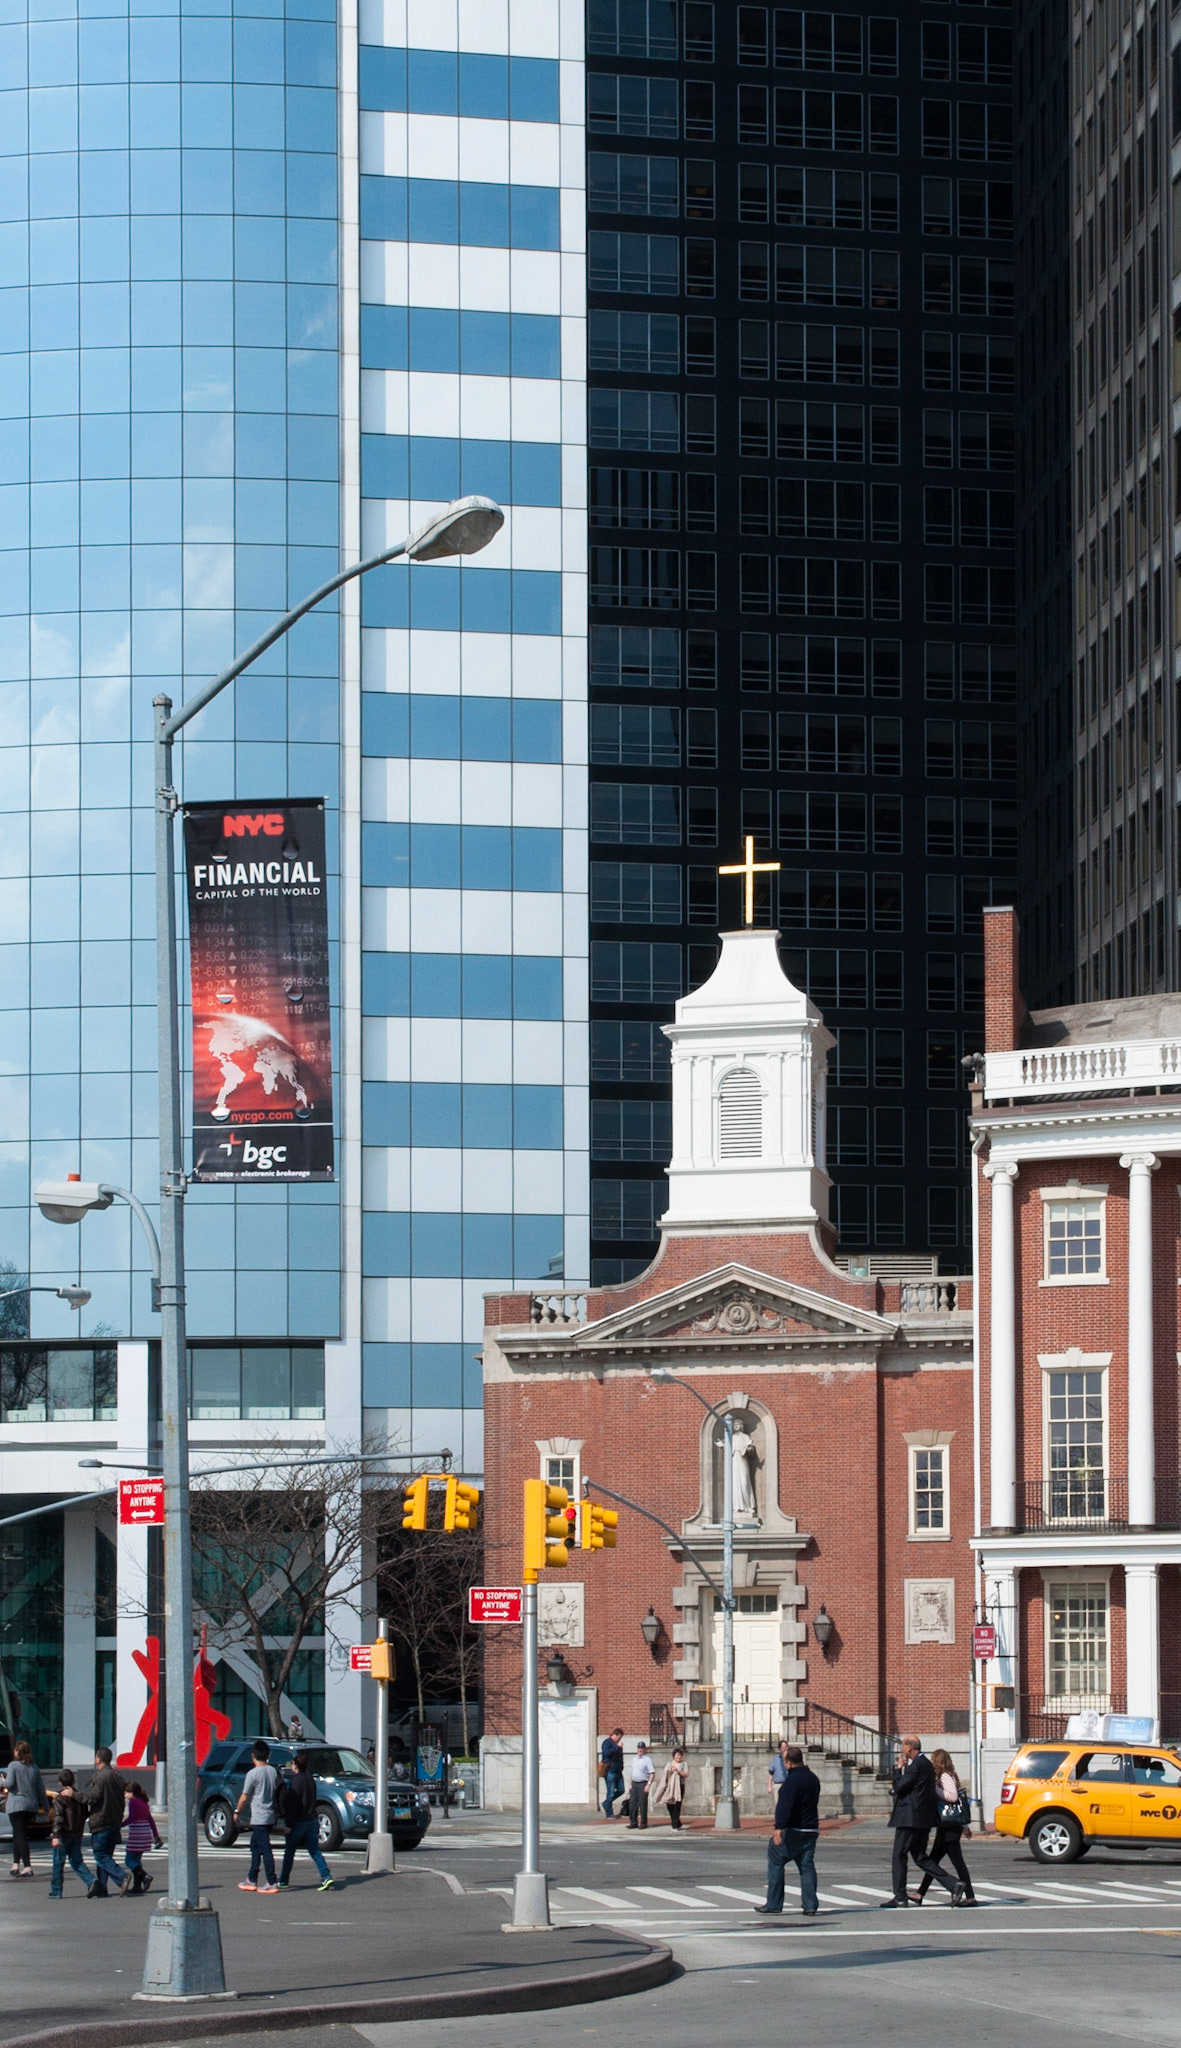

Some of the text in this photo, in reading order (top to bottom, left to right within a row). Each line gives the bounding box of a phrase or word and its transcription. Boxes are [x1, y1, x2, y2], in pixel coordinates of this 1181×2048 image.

[223, 814, 285, 838] NYC
[193, 861, 321, 887] FINANCIAL
[196, 887, 321, 900] CAPITAL OF THE WORLD
[230, 1111, 294, 1124] nycgo.com
[242, 1140, 287, 1169] bgc
[241, 1170, 275, 1178] electronic
[276, 1169, 311, 1178] brokerage
[123, 1483, 162, 1494] NO STOPPING
[130, 1496, 156, 1507] ANYTIME
